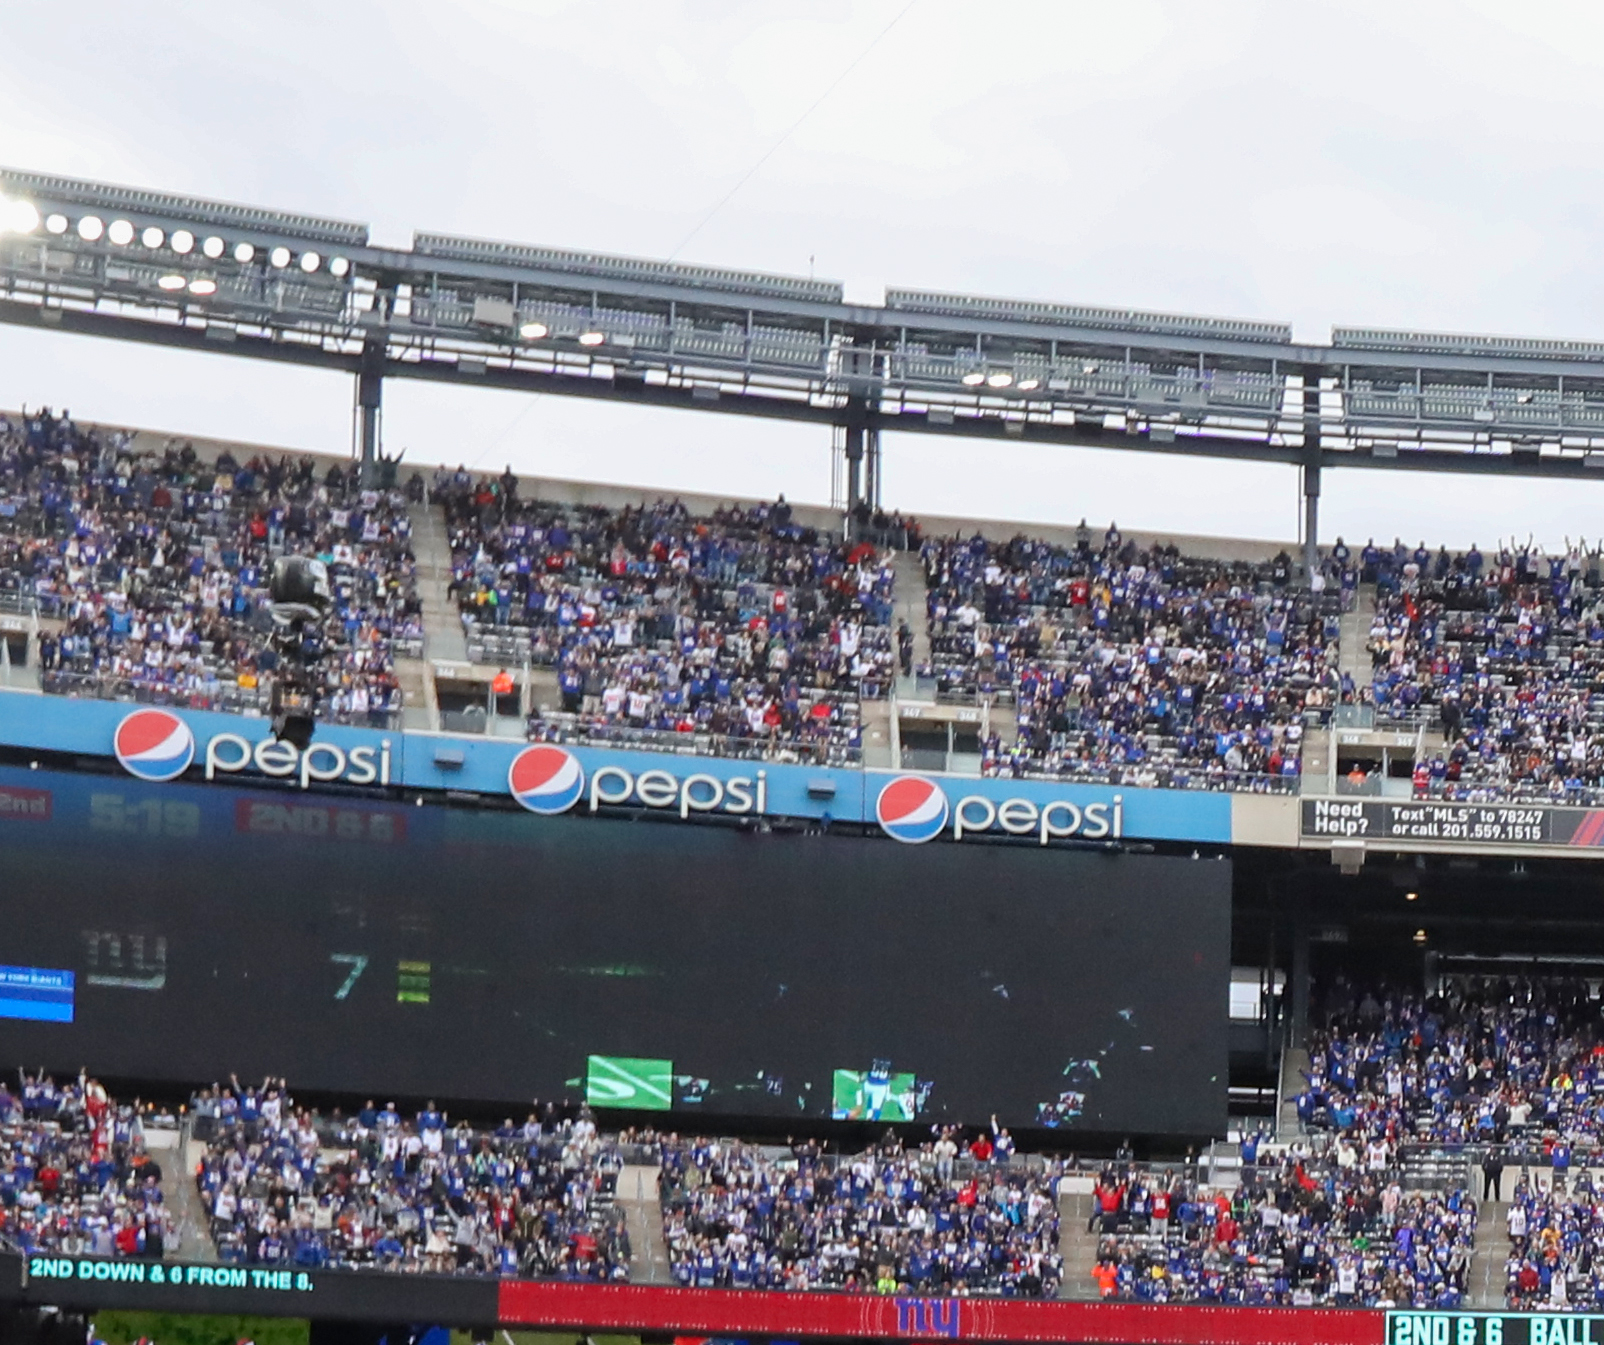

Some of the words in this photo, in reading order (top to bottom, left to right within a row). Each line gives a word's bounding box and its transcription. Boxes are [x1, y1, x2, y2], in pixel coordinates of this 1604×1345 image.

[206, 732, 391, 788] pepsi
[590, 766, 767, 819] pepsi
[954, 795, 1122, 845] pepsi
[1315, 802, 1362, 818] Need
[1392, 808, 1425, 822] Text
[1480, 809, 1495, 823] to
[1500, 811, 1543, 824] 78247
[1315, 818, 1368, 837] Help?
[1393, 825, 1409, 835] or
[1410, 823, 1439, 836] call
[1442, 824, 1541, 840] 201.559.1515
[330, 953, 369, 1000] 7
[31, 1258, 73, 1276] 2ND
[79, 1261, 144, 1283] DOWN
[149, 1264, 164, 1283] &
[170, 1265, 182, 1284] 6
[188, 1266, 248, 1288] FROM
[253, 1270, 291, 1290] THE
